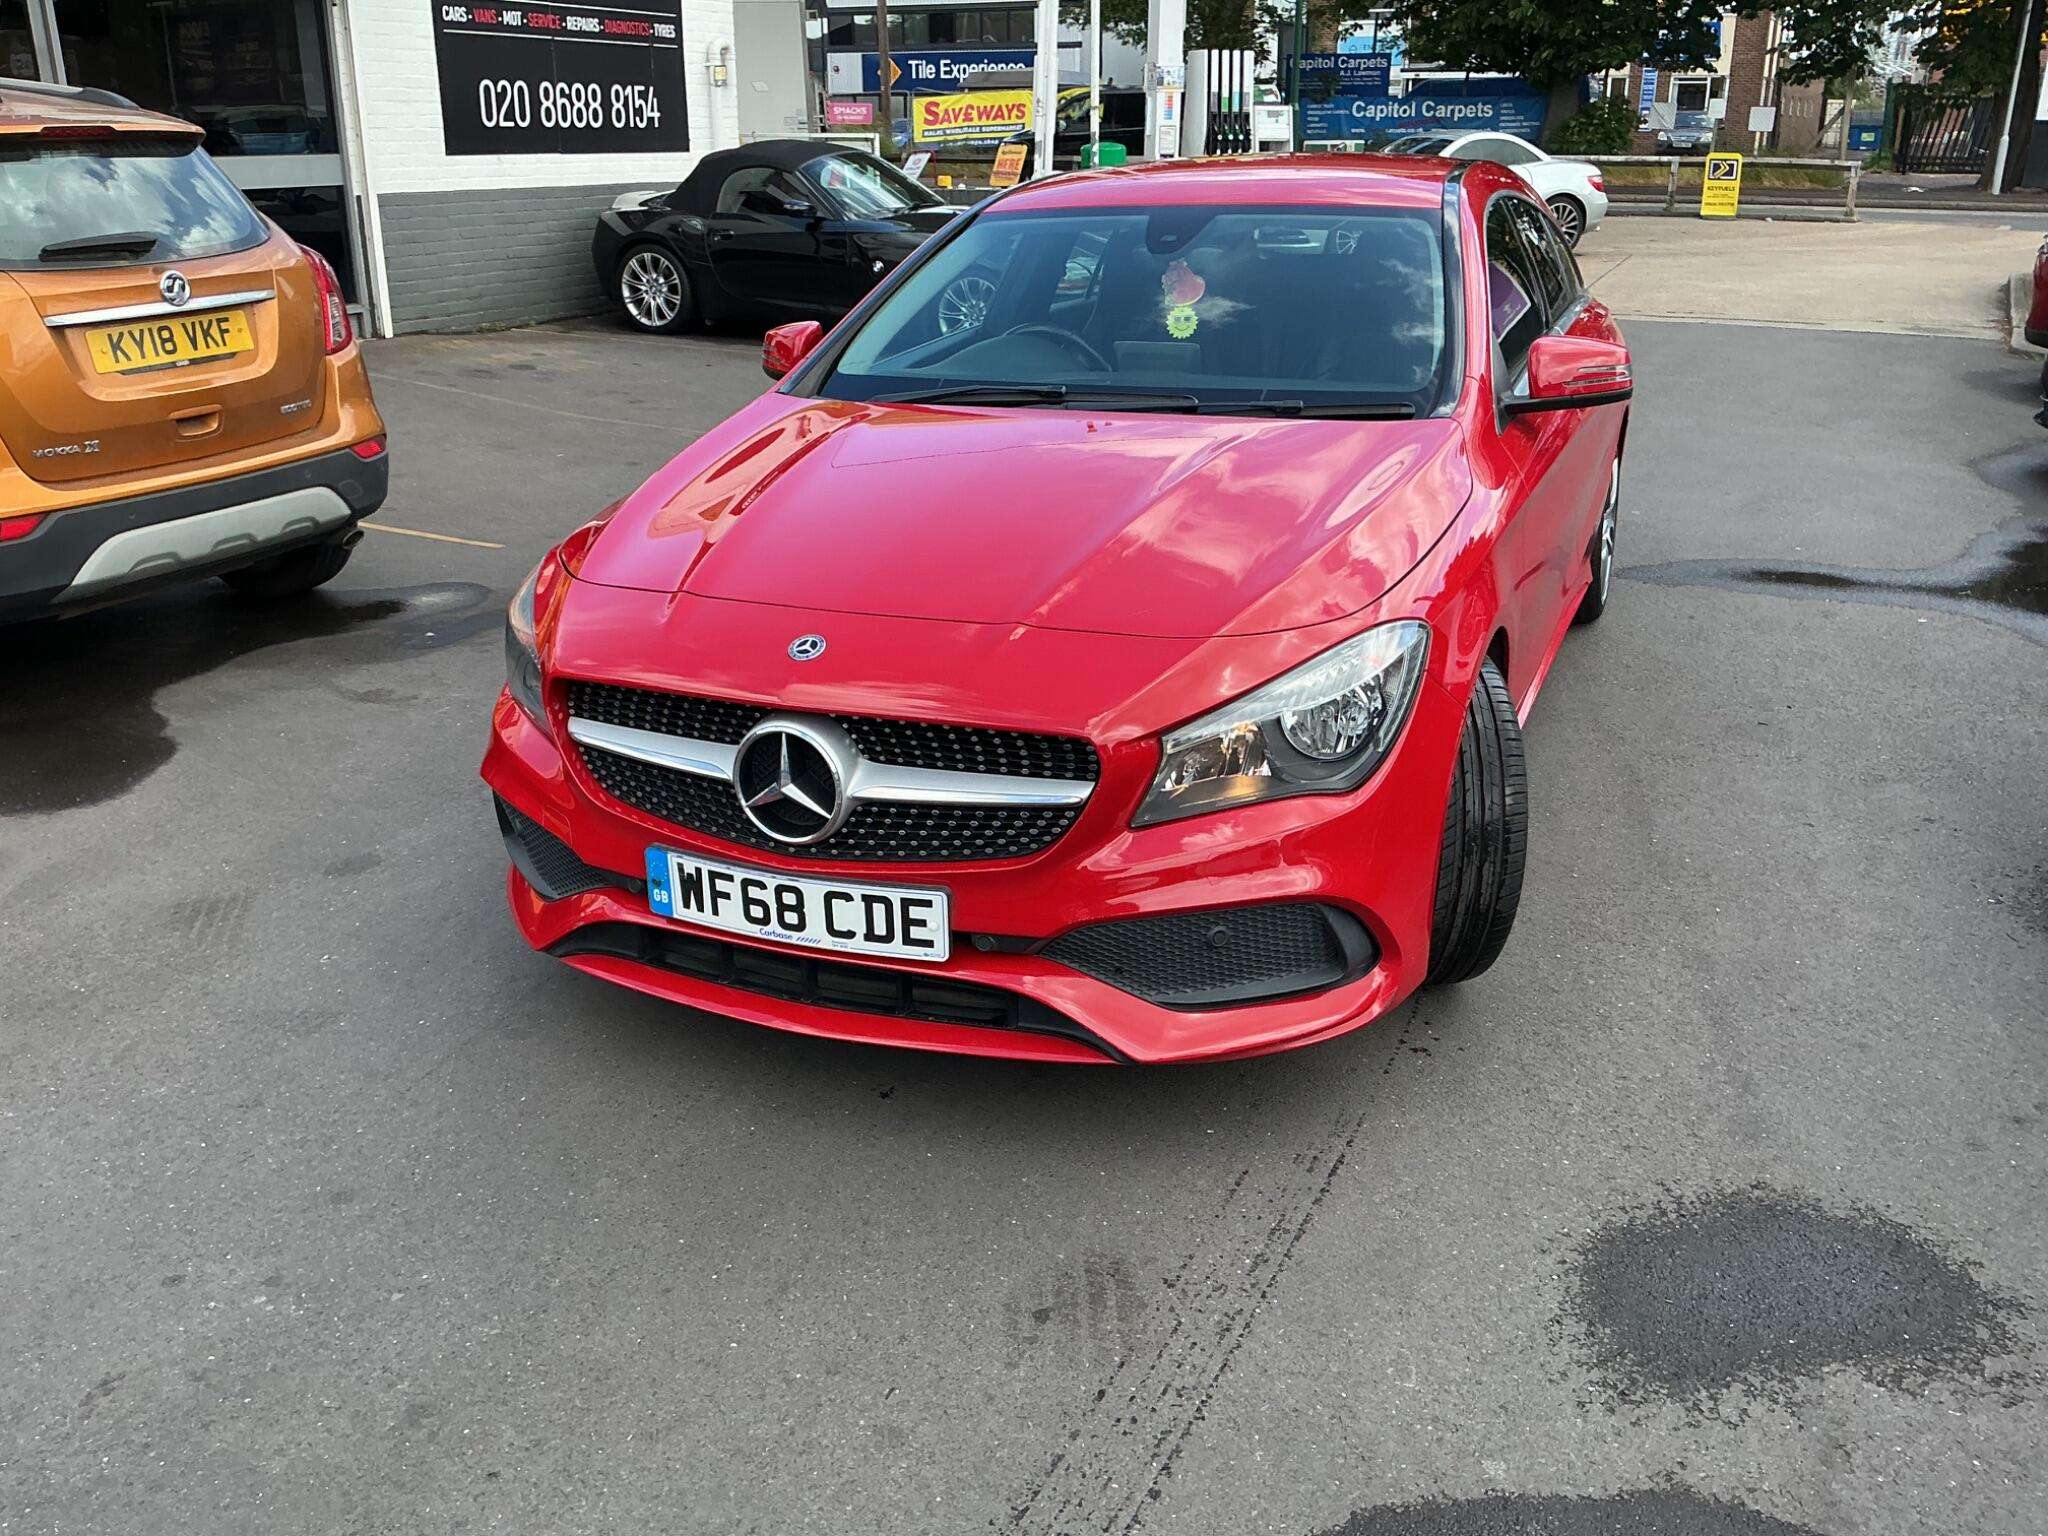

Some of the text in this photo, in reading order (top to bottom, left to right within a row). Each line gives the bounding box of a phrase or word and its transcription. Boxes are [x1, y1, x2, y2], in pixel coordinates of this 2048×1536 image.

[442, 5, 676, 38] CARS VANS MOT SERVICE REPAIRS DIAGNOSTICS TYRES
[907, 59, 936, 79] Tile
[1338, 56, 1388, 70] Carpets
[478, 79, 661, 129] 020 8688 8154
[1352, 101, 1416, 121] Capitol
[1421, 101, 1494, 121] Carpets
[107, 317, 232, 364] KY18 VKF
[653, 888, 669, 904] GB
[677, 862, 935, 948] WF68 CDE
[759, 927, 793, 941] Carbase
